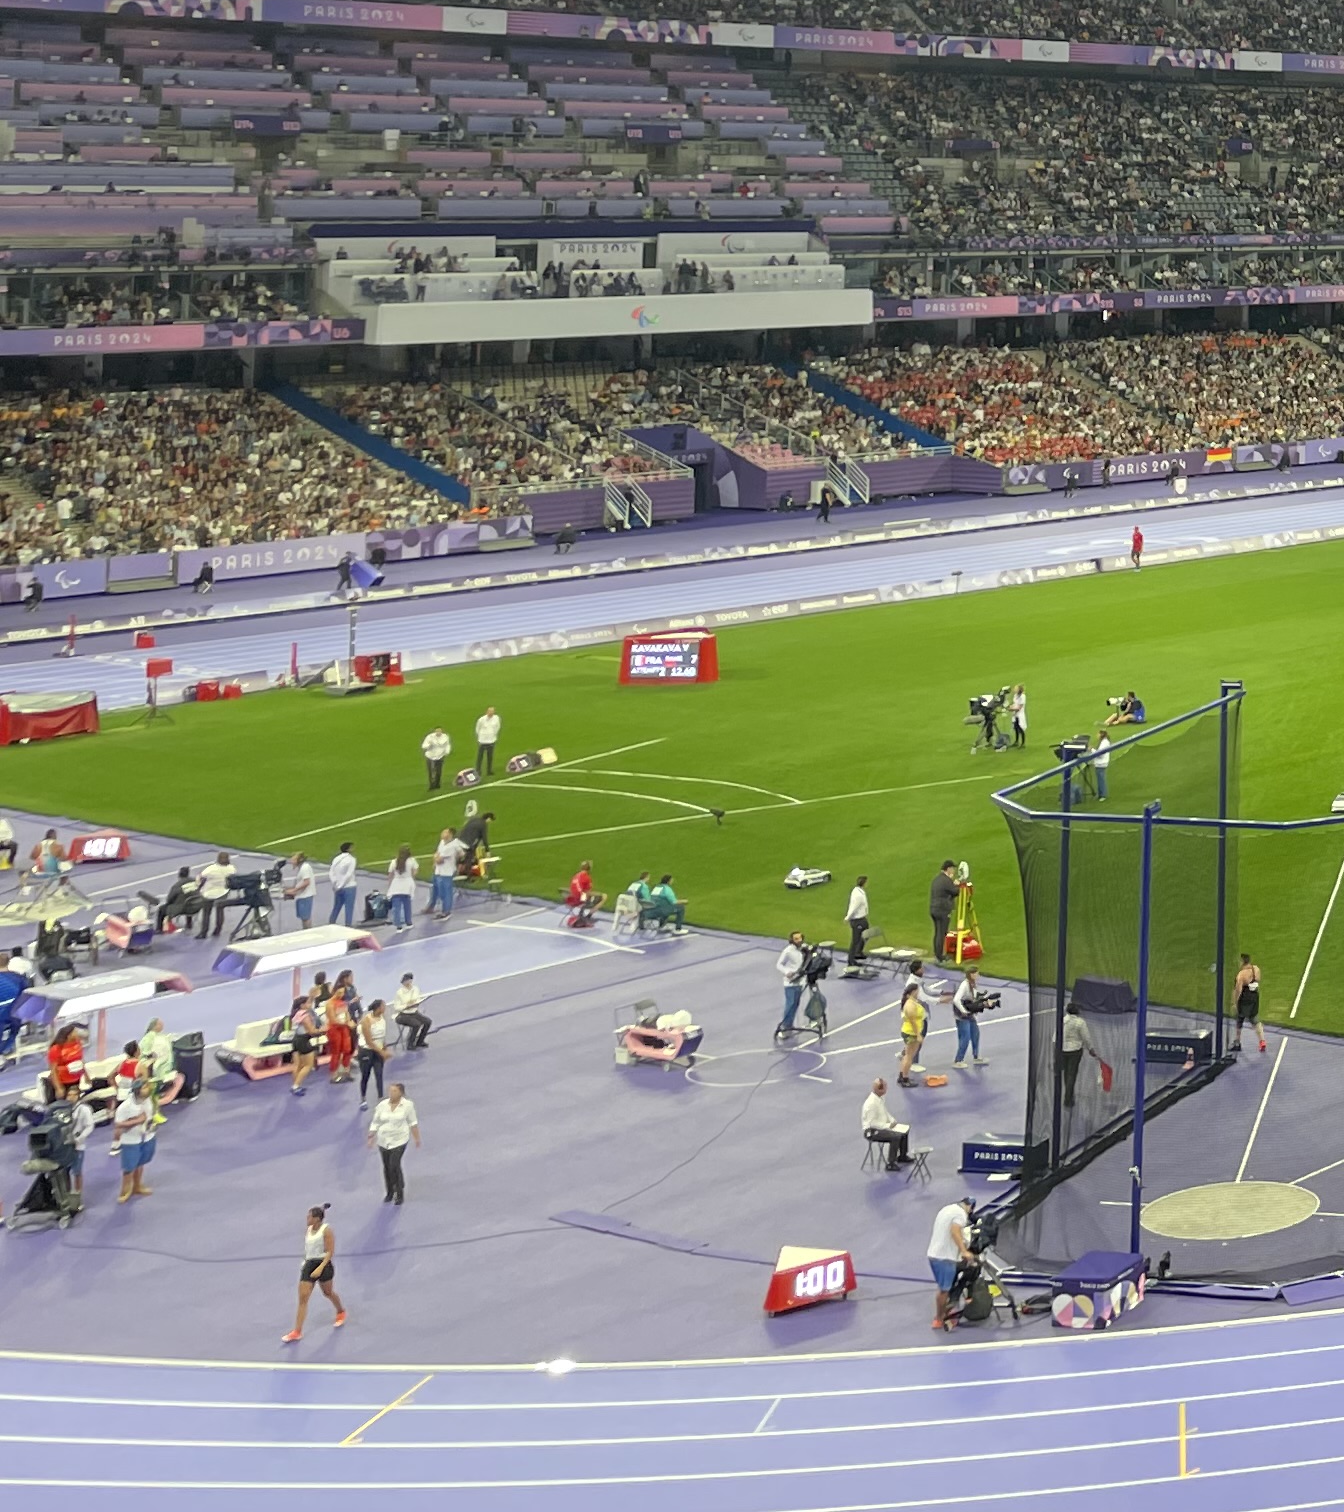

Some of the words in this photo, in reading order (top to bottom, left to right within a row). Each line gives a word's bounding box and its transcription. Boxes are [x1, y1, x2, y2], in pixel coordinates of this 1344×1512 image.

[303, 4, 354, 20] PARIS
[360, 7, 405, 22] 2024
[795, 32, 834, 47] PARIS
[838, 35, 874, 48] 2024
[1304, 58, 1336, 70] PARIS
[560, 242, 597, 254] PARIS
[602, 242, 637, 254] 2024
[1157, 294, 1184, 304] PARIS
[1187, 293, 1212, 303] 2024
[1305, 289, 1332, 298] PARIS
[925, 303, 957, 313] PARIS
[960, 302, 988, 312] 2024
[53, 333, 103, 348] PARIS
[107, 332, 152, 347] 2024
[1109, 462, 1148, 476] PARIS
[1152, 459, 1186, 473] 204
[212, 551, 274, 570] PARIS
[283, 544, 338, 564] 2024
[715, 610, 749, 623] TOYOTA
[631, 644, 682, 653] KAVAKAVA
[645, 656, 663, 665] FRA
[690, 654, 698, 665] 7
[974, 1151, 999, 1161] PARIS
[1001, 1151, 1024, 1161] 2024
